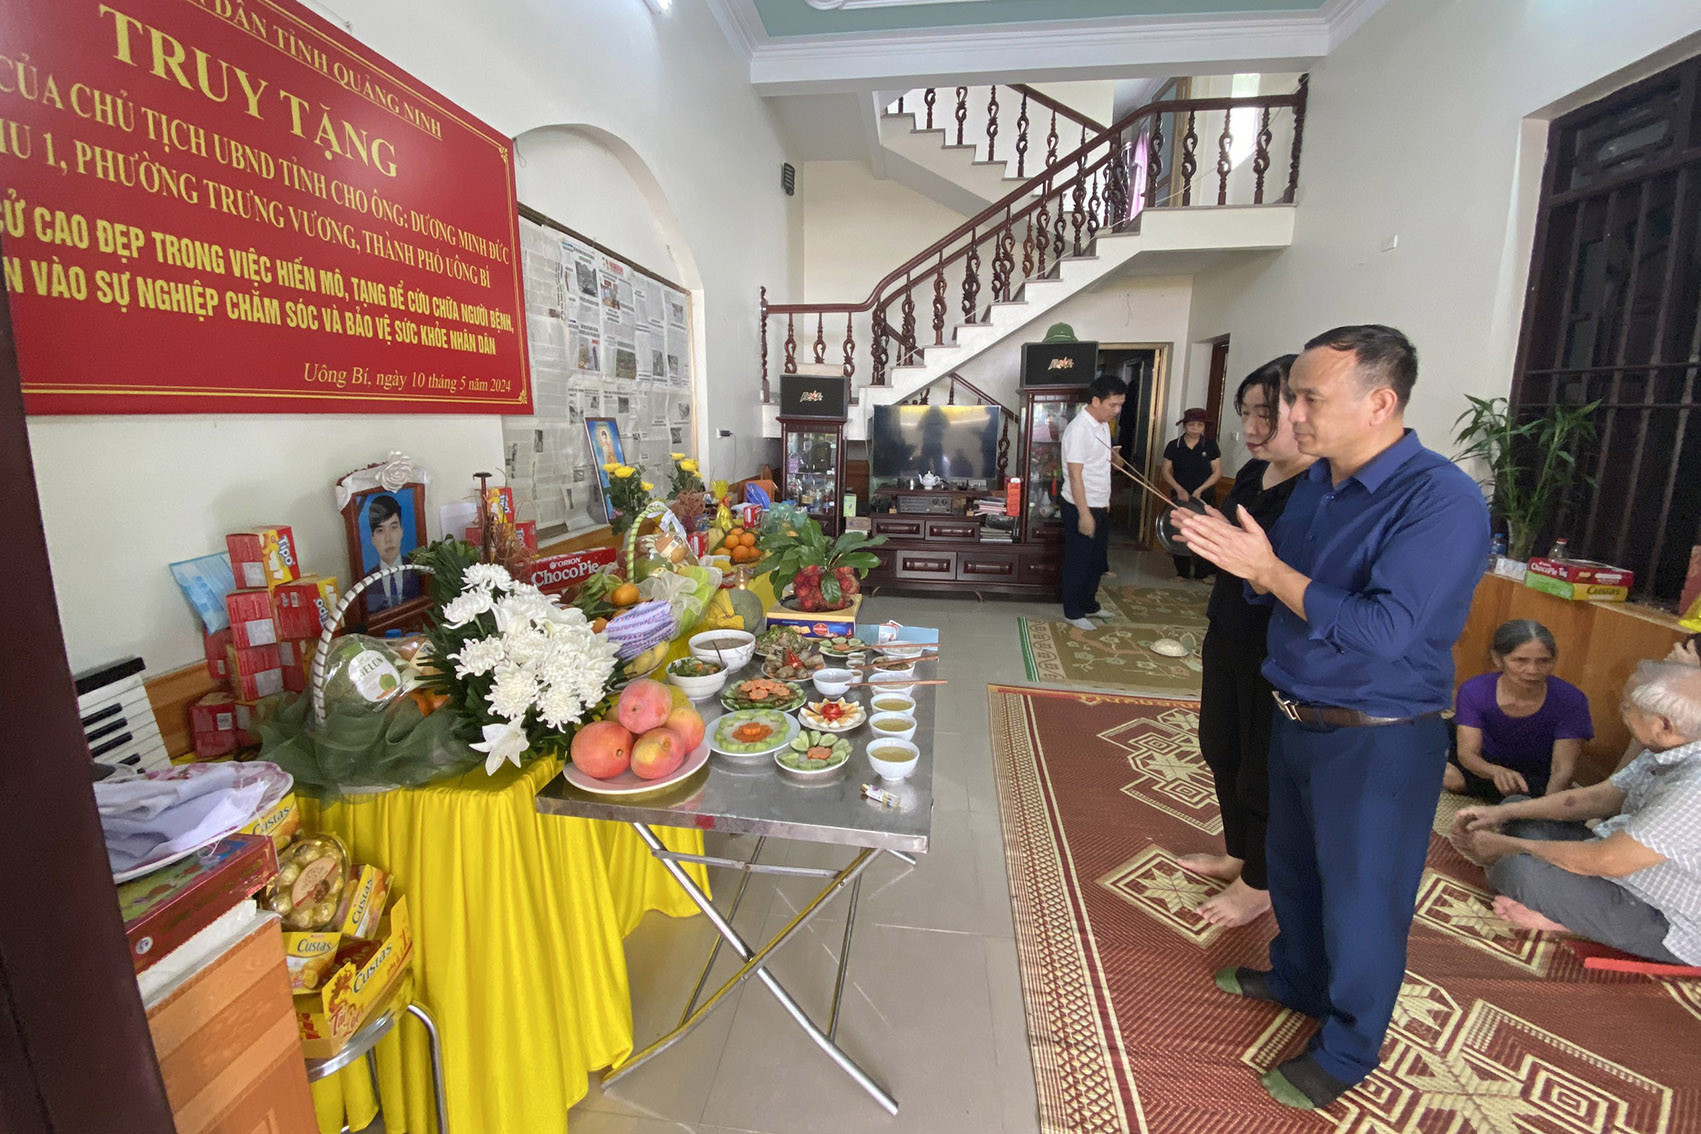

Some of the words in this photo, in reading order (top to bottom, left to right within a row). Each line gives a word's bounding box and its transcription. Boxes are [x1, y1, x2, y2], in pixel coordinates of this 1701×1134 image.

[98, 3, 268, 120] TRUY
[280, 89, 397, 177] TẶNG
[273, 25, 327, 73] TỈNH
[333, 62, 399, 113] QUẢNG
[403, 102, 442, 138] NINH
[0, 53, 64, 110] CỦA
[70, 83, 136, 132] CHỦ
[141, 107, 208, 158] TỊCH
[213, 133, 275, 180] UBND
[278, 156, 327, 200] TỈNH
[331, 180, 368, 213] CHO
[371, 189, 408, 220] ÔNG:
[411, 210, 456, 247] DƯƠNG
[458, 230, 487, 257] MINH
[488, 239, 510, 265] ĐỨC
[43, 132, 68, 176] 1,
[74, 139, 198, 204] PHƯỜNG
[203, 179, 285, 228] TRƯNG
[288, 206, 361, 255] VƯƠNG,
[362, 230, 415, 266] THÀNH
[417, 247, 443, 275] PHỐ
[445, 256, 478, 284] UÔNG
[480, 265, 491, 288] BÍ
[33, 206, 90, 249] CAO
[96, 219, 145, 263] ĐẸP
[151, 231, 226, 275] TRONG
[229, 247, 272, 287] VIỆC
[276, 257, 316, 293] HIẾN
[319, 268, 349, 302] MÔ,
[352, 277, 387, 308] TẠNG
[389, 279, 405, 311] ĐỂ
[407, 288, 430, 316] CỨU
[432, 296, 459, 322] CHỮA
[461, 302, 489, 327] NGƯỜI
[30, 255, 87, 301] VÀO
[95, 270, 130, 313] SỰ
[136, 276, 219, 322] NGHIỆP
[225, 289, 281, 326] CHĂM
[286, 297, 319, 331] SÓC
[321, 304, 343, 335] VÀ
[345, 305, 373, 339] BẢO
[376, 315, 392, 346] VỆ
[394, 319, 418, 346] SỨC
[450, 332, 477, 354] NHÂN
[478, 334, 496, 356] DÂN
[303, 362, 347, 389] Uông
[376, 373, 407, 391] ngày
[412, 371, 425, 387] 10
[428, 375, 457, 393] tháng
[459, 376, 466, 390] 5
[468, 379, 488, 391] năm
[490, 378, 511, 393] 2024
[277, 534, 294, 567] Tipo
[558, 557, 581, 568] ORION
[252, 806, 290, 835] Custas
[351, 877, 374, 925] Custas
[297, 938, 332, 953] Custas
[352, 942, 393, 993] Custas
